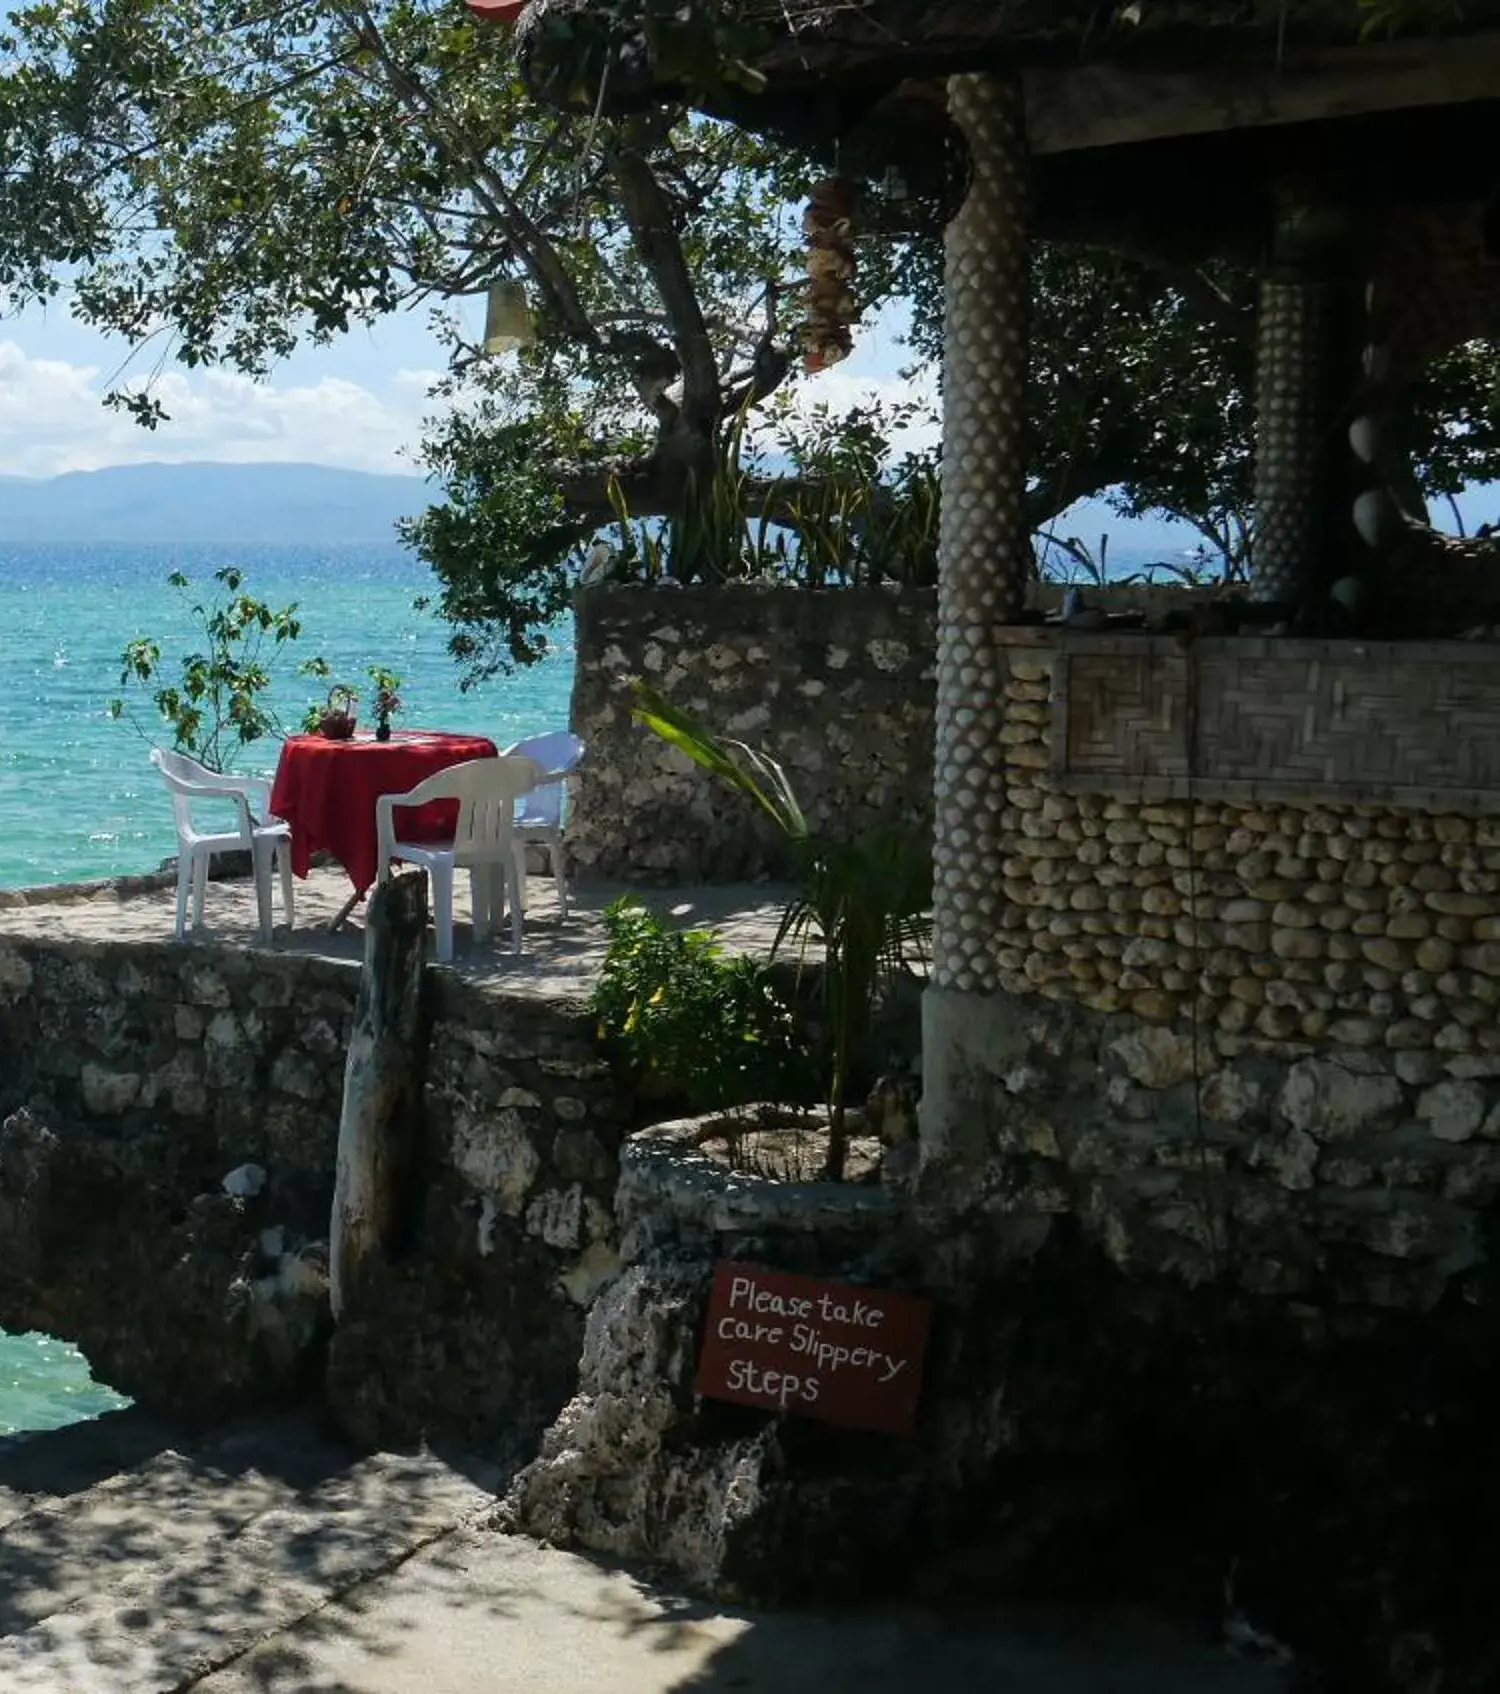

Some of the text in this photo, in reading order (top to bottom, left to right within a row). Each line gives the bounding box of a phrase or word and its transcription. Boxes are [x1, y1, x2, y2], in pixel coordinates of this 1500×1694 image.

[729, 1277, 885, 1328] Please take
[789, 1323, 907, 1382] Slippery
